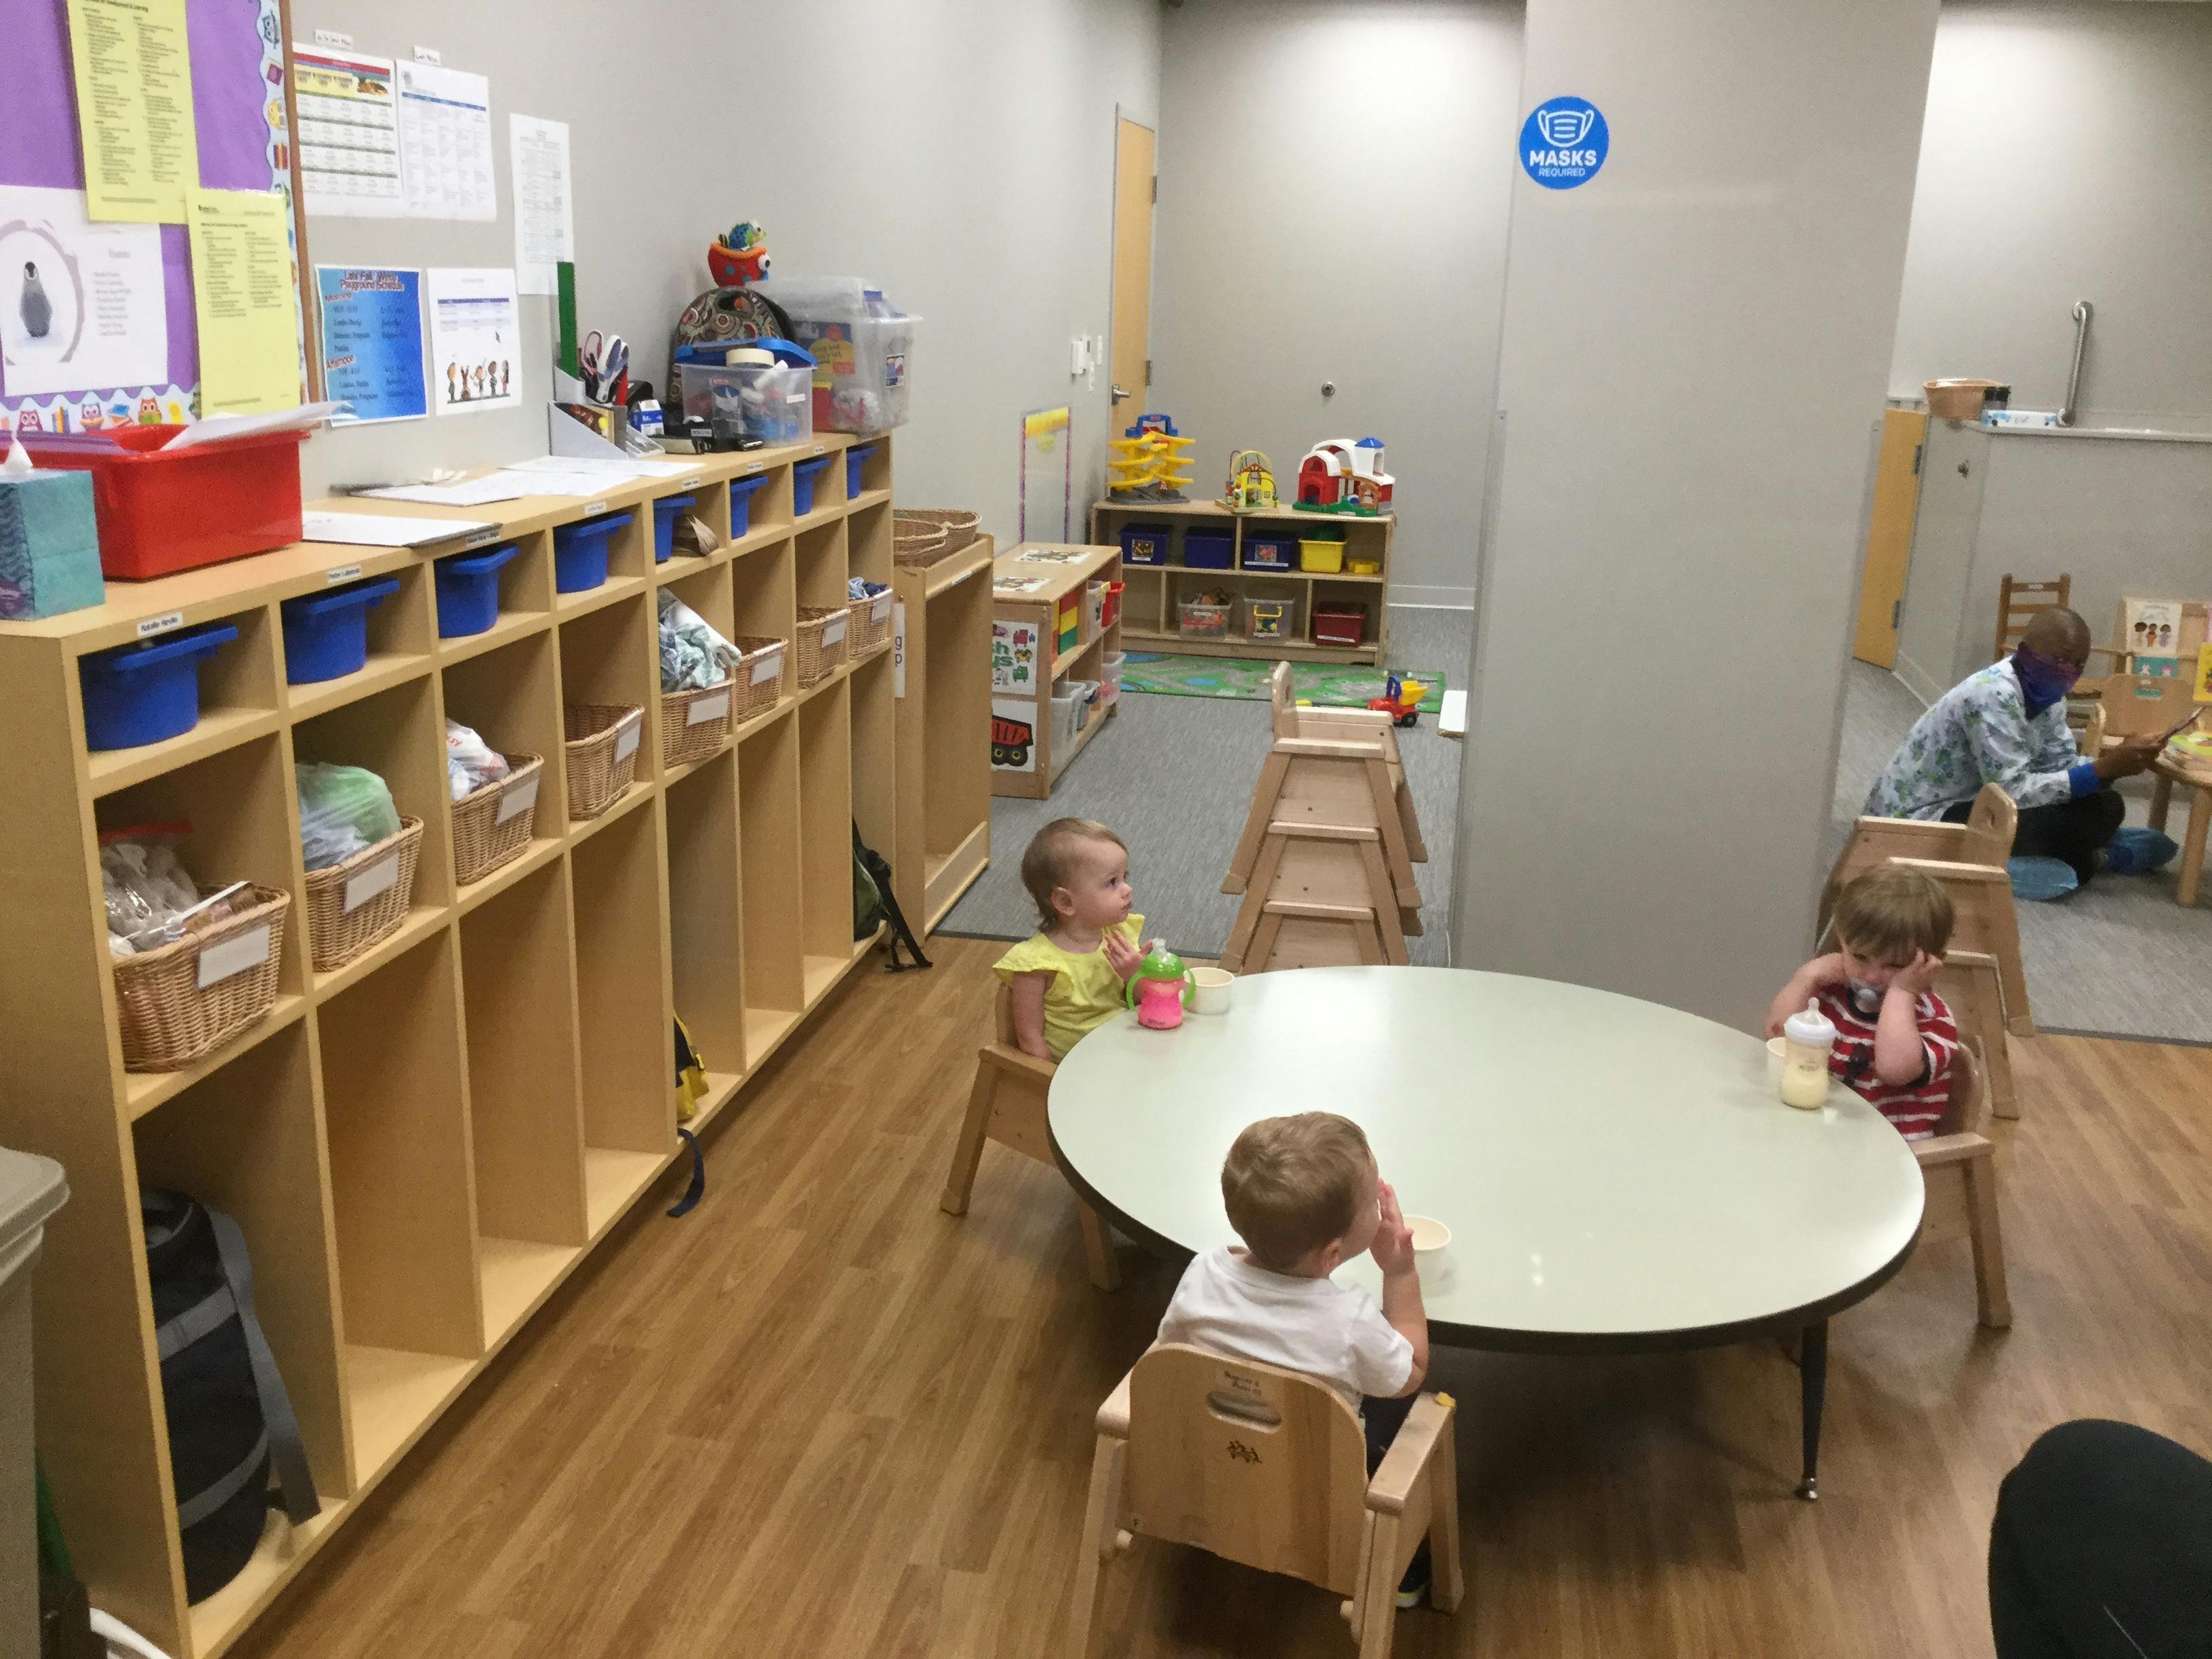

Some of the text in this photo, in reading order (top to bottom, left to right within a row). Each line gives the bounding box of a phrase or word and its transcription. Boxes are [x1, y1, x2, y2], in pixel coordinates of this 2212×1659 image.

[1529, 150, 1597, 166] MASKS
[1538, 167, 1586, 177] REQUIRED
[340, 280, 374, 291] Playground
[325, 293, 352, 302] Morning
[327, 354, 354, 369] Afternoon
[895, 636, 903, 651] g
[895, 653, 903, 668] p
